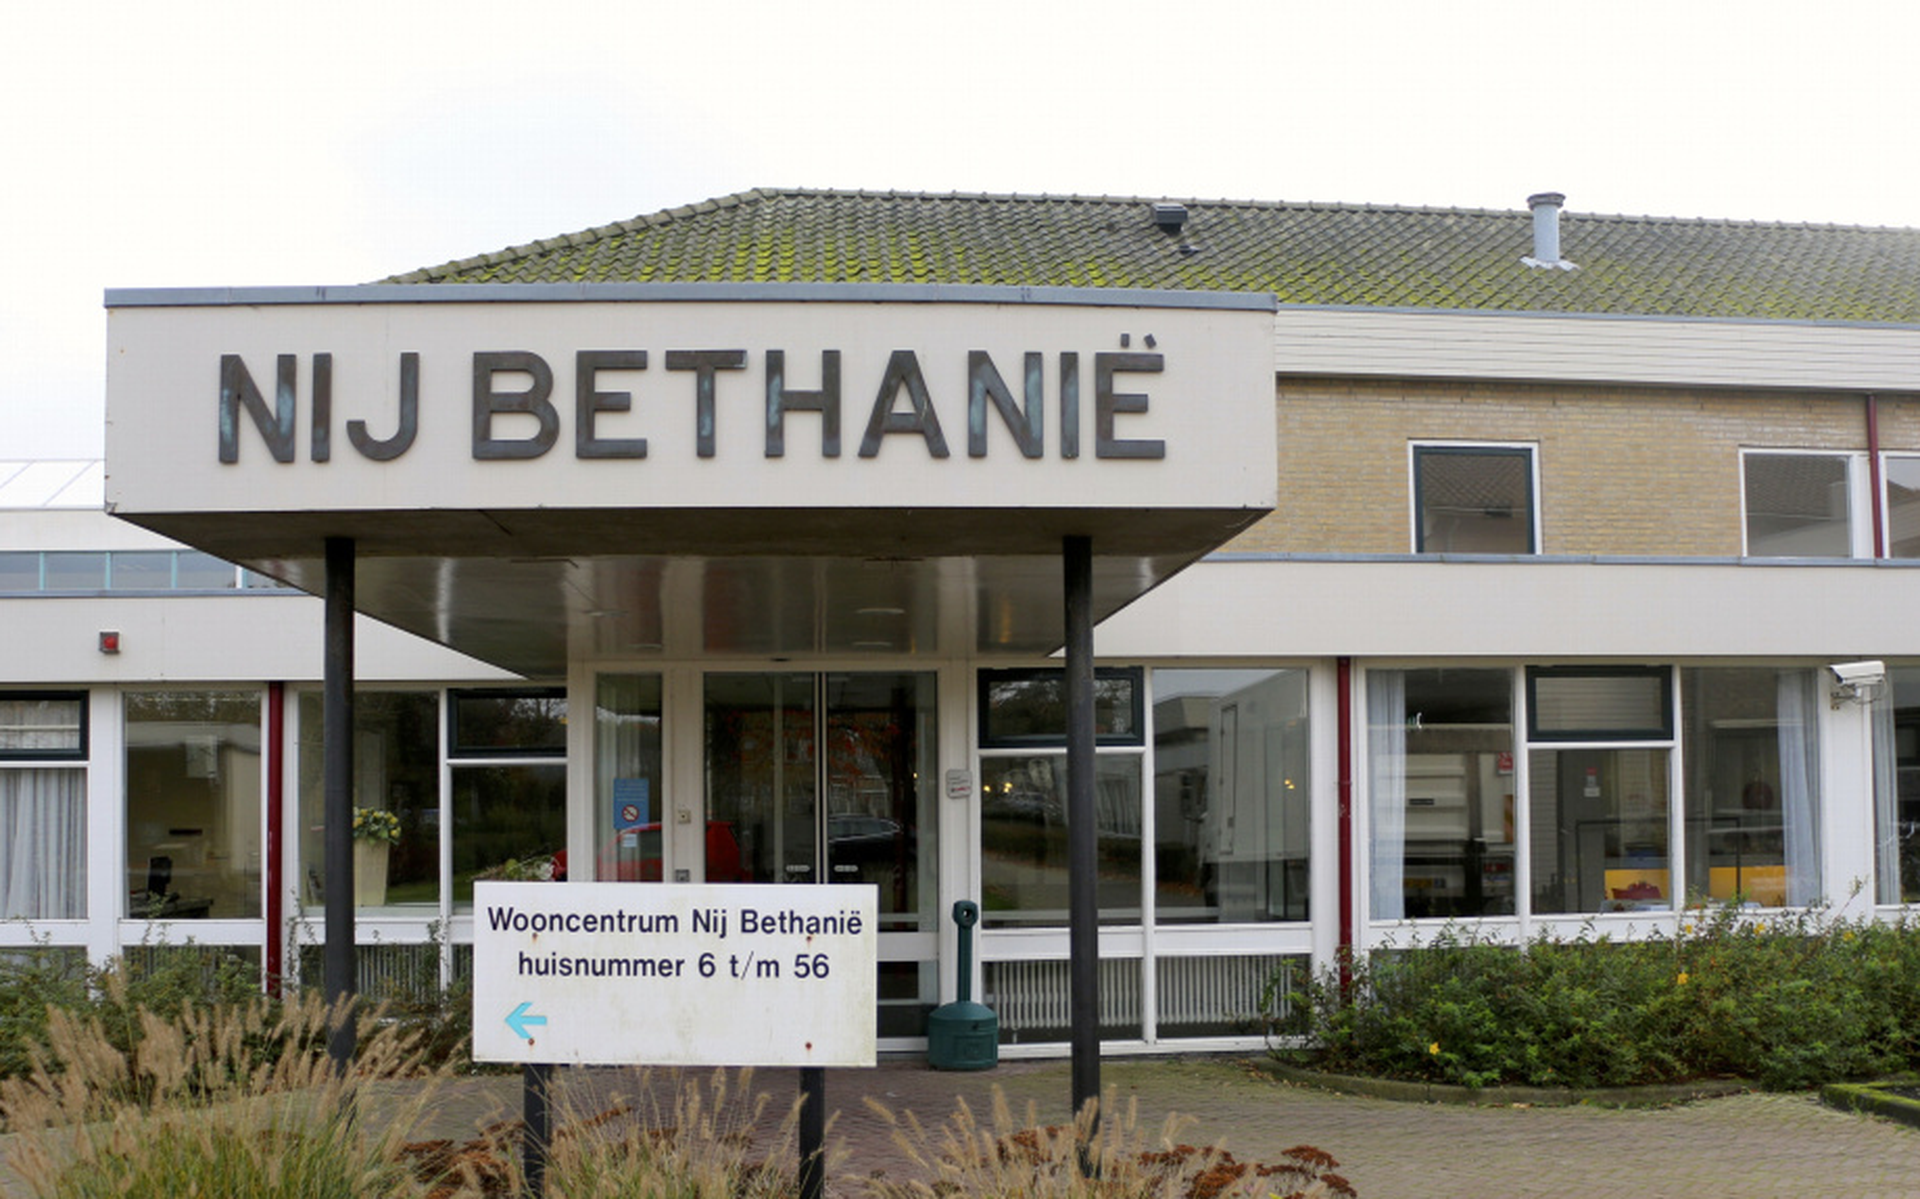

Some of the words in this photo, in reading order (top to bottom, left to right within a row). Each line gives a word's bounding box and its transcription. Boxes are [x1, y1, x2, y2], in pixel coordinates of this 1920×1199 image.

[218, 351, 420, 464] NIJ
[471, 333, 1167, 463] BETHANIË
[487, 906, 679, 933] Wooncentrum
[692, 908, 728, 939] Nij
[740, 908, 863, 935] Bethanië
[518, 950, 686, 978] huisnummer
[698, 952, 717, 979] 6
[728, 950, 780, 980] t/m
[793, 953, 830, 979] 56
